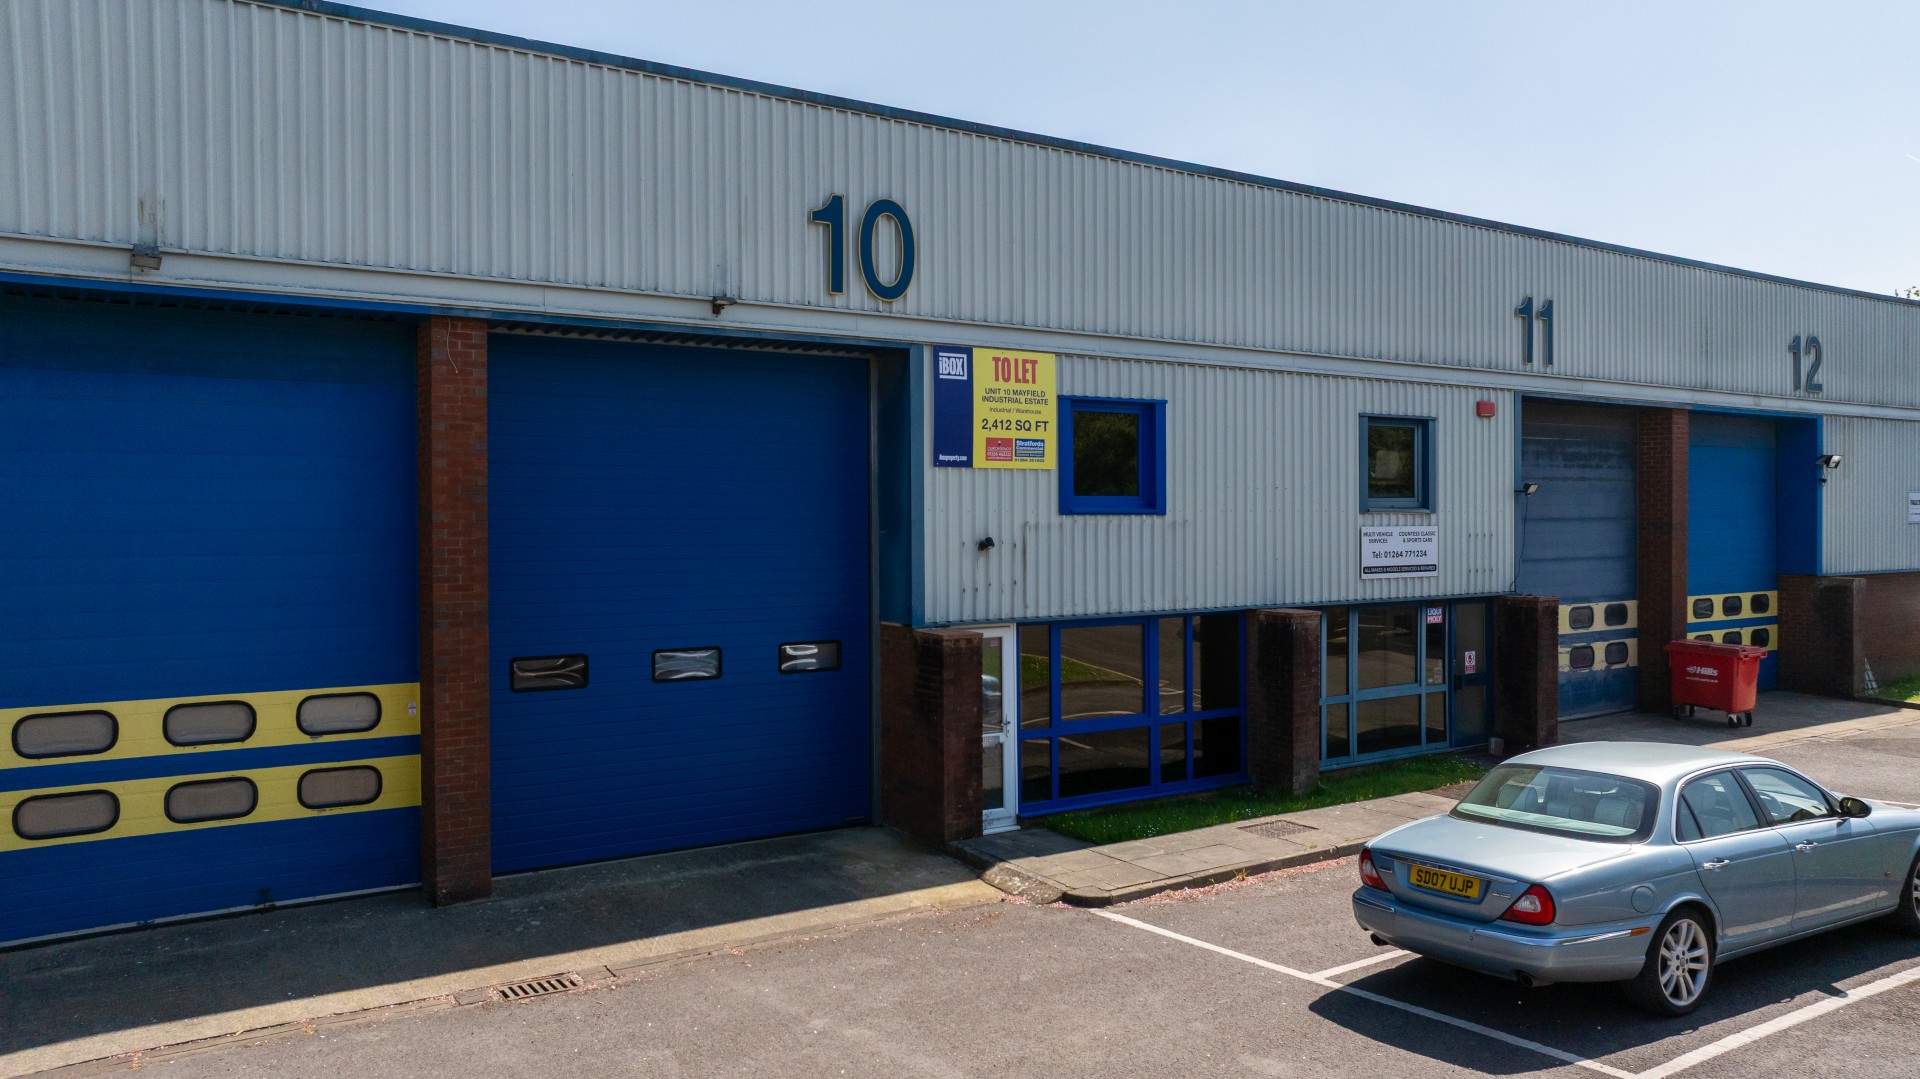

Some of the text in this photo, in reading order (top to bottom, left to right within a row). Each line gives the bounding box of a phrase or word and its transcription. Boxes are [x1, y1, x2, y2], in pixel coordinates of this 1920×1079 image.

[810, 193, 915, 302] 10
[1516, 296, 1554, 366] 11
[939, 357, 964, 376] iBOX
[992, 356, 1038, 384] TO LET
[1789, 335, 1823, 393] 12
[981, 395, 1049, 406] INDUSTRIAL ESTATE
[985, 387, 1001, 395] UNIT
[1012, 389, 1046, 398] MAYFIELD
[989, 406, 1011, 414] Industrial
[1015, 407, 1042, 415] Warehouse
[981, 418, 1049, 432] 2,412 SQ FT
[1372, 549, 1427, 559] Tel: 01264 771234
[1427, 615, 1442, 623] MOLY
[1415, 869, 1474, 893] SD07 UJP
